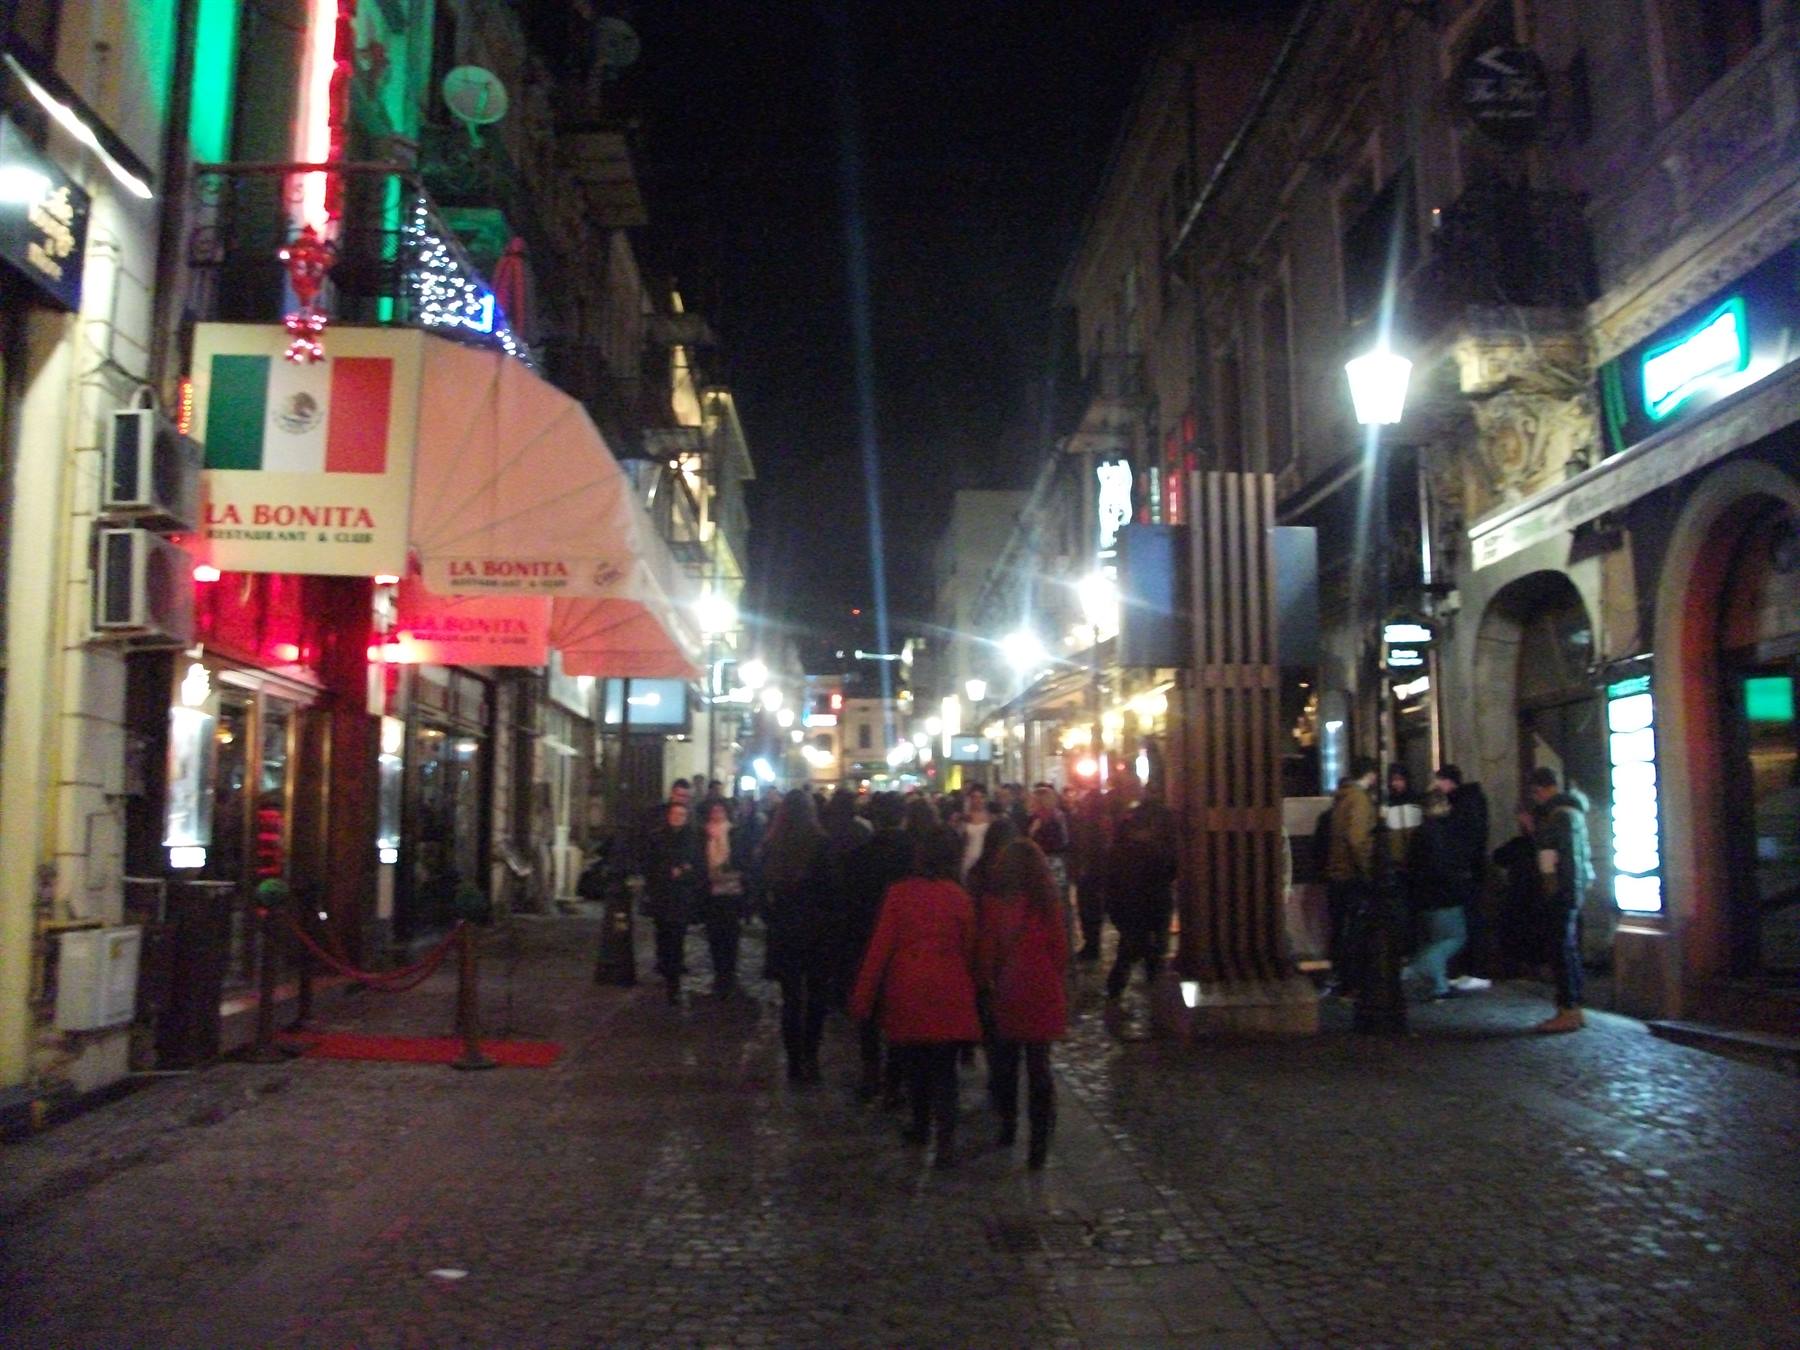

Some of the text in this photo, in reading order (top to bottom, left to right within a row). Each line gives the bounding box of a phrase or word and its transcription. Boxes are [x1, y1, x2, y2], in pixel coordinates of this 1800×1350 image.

[204, 503, 376, 528] LA BONITA
[317, 531, 328, 542] &
[334, 532, 373, 543] CLUB
[449, 560, 567, 577] LA BONITA
[445, 617, 528, 633] BONITA
